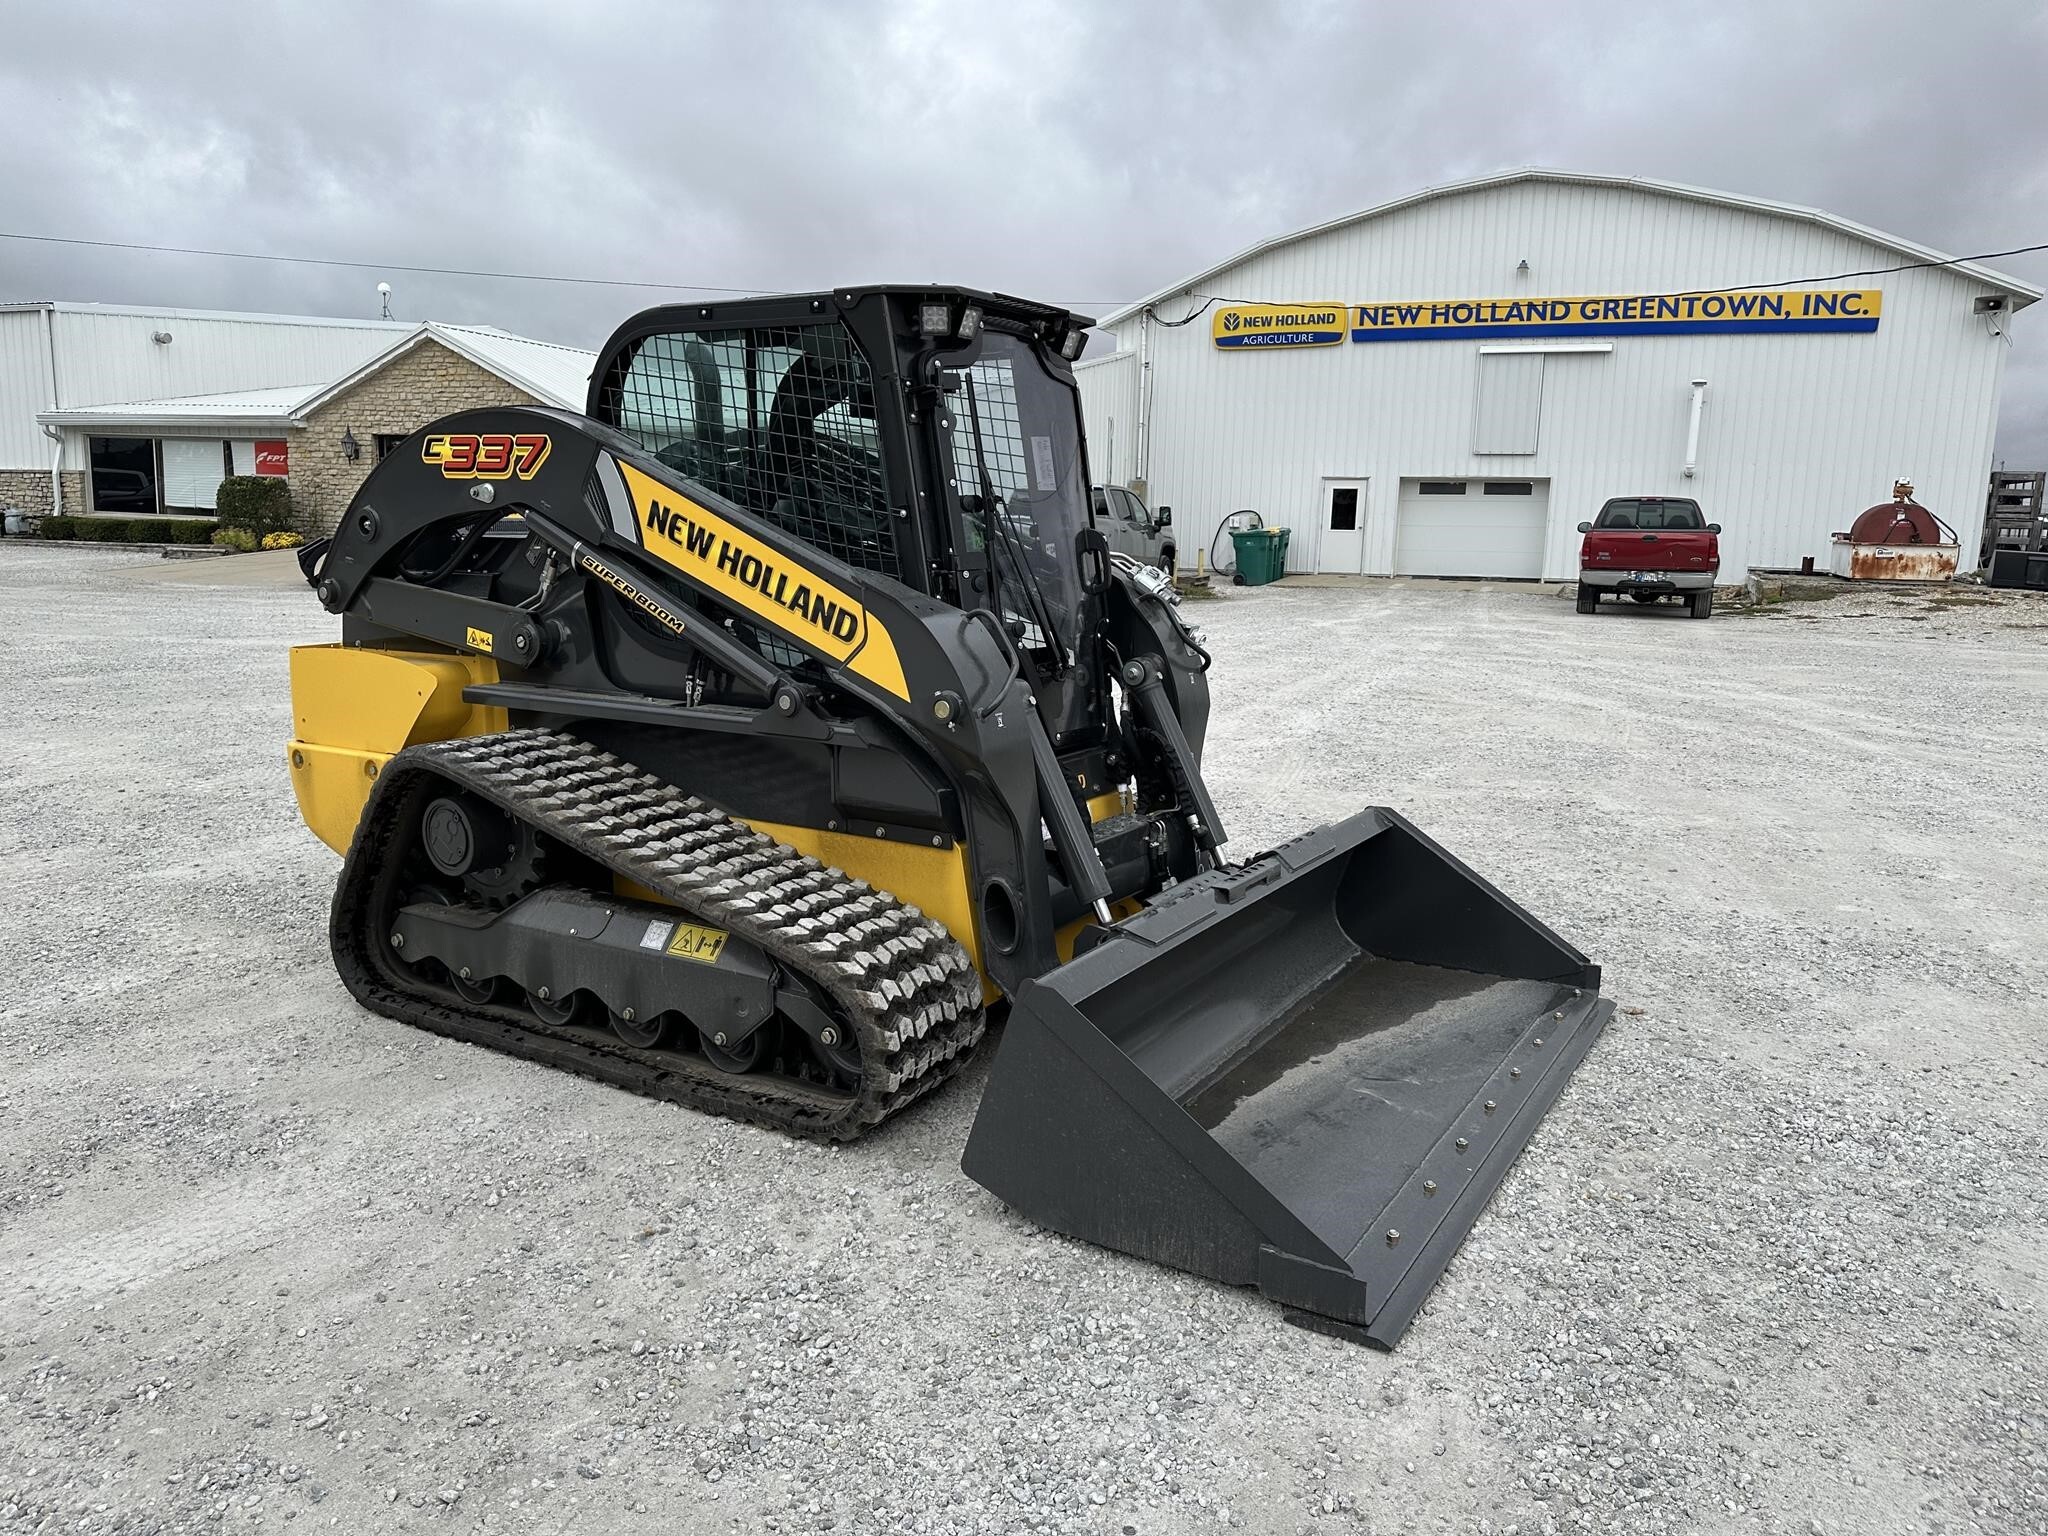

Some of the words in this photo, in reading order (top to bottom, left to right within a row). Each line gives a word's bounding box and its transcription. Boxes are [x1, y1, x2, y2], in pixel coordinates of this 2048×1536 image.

[1243, 315, 1273, 328] NEW
[1275, 312, 1336, 326] HOLLAND
[1358, 304, 1424, 327] NEW
[1430, 300, 1571, 325] HOLLAND
[1579, 294, 1792, 321] GREENTOWN,
[1802, 293, 1869, 317] INC.
[1242, 333, 1314, 345] AGRICULTURE
[266, 454, 286, 462] FPT
[646, 499, 717, 562] NEW
[716, 540, 858, 644] HOLLAND
[582, 555, 637, 600] SUPER
[634, 592, 685, 634] BOOM
